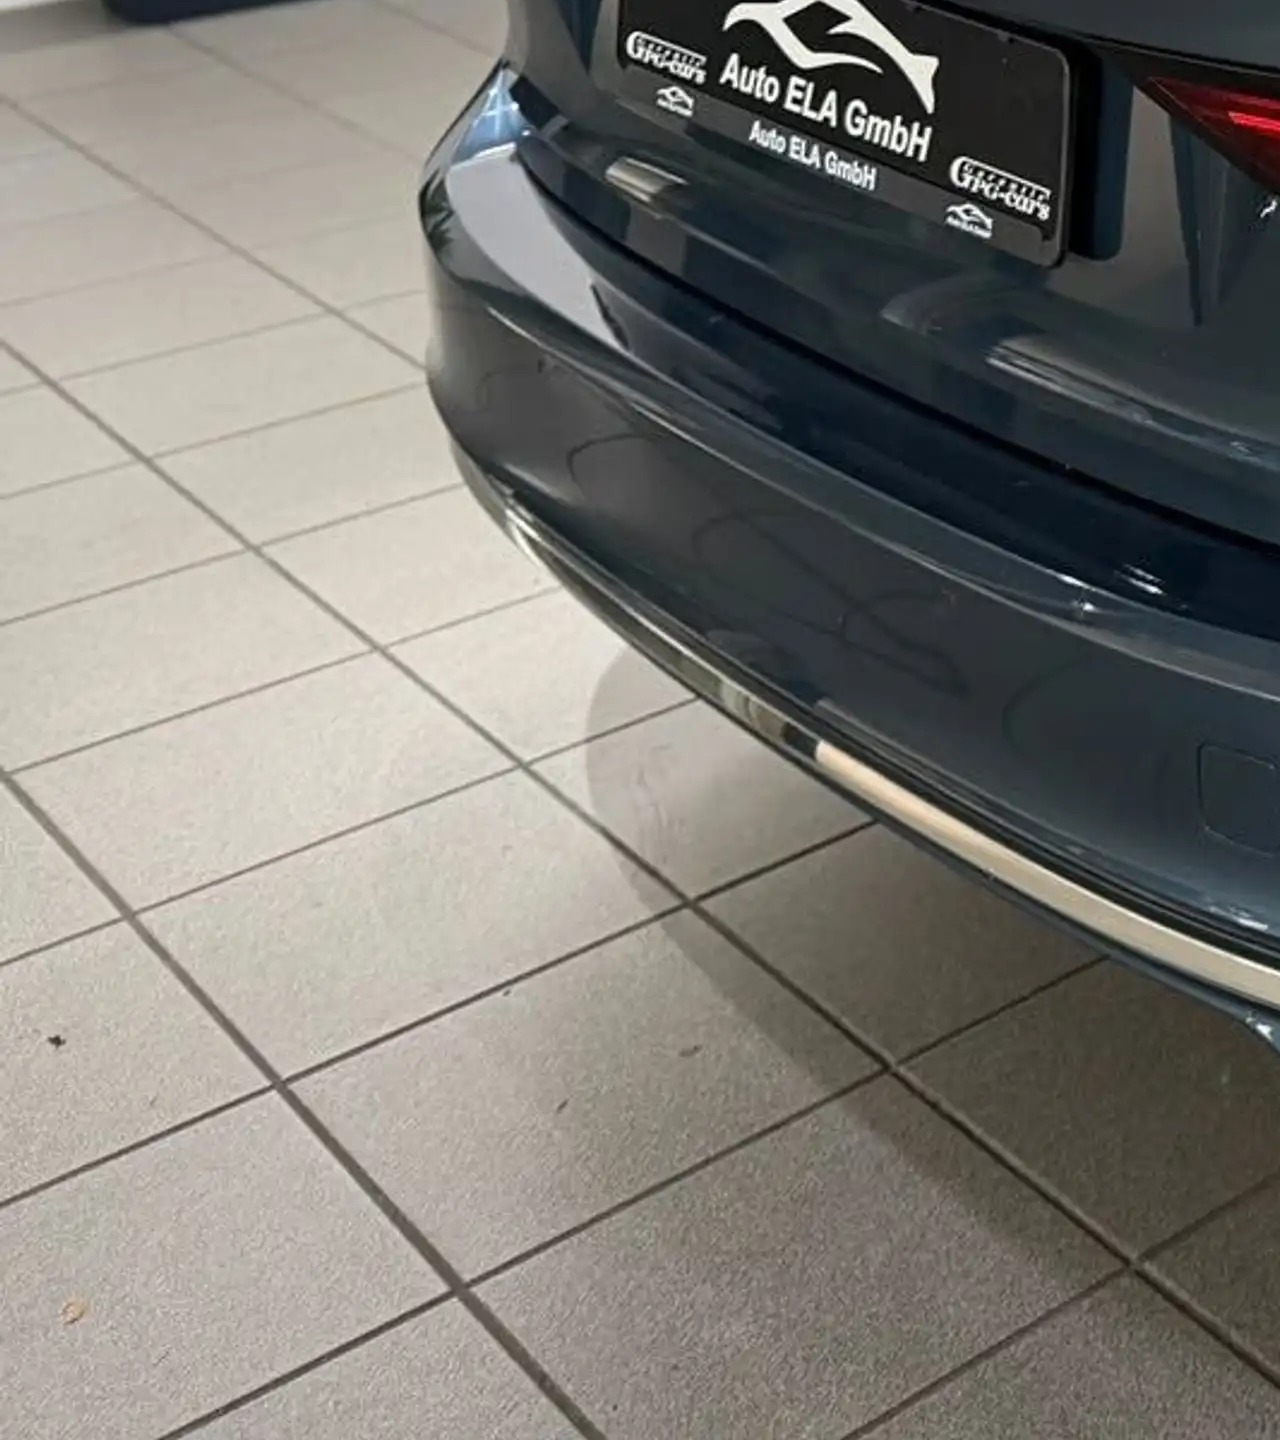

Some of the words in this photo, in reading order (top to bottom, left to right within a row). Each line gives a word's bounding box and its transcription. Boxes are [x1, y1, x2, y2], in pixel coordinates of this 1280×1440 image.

[719, 53, 780, 104] Auto
[784, 77, 837, 129] ELA
[845, 105, 932, 161] GmbH
[749, 120, 786, 153] Auto
[789, 137, 821, 168] ELA
[826, 151, 877, 191] GmbH
